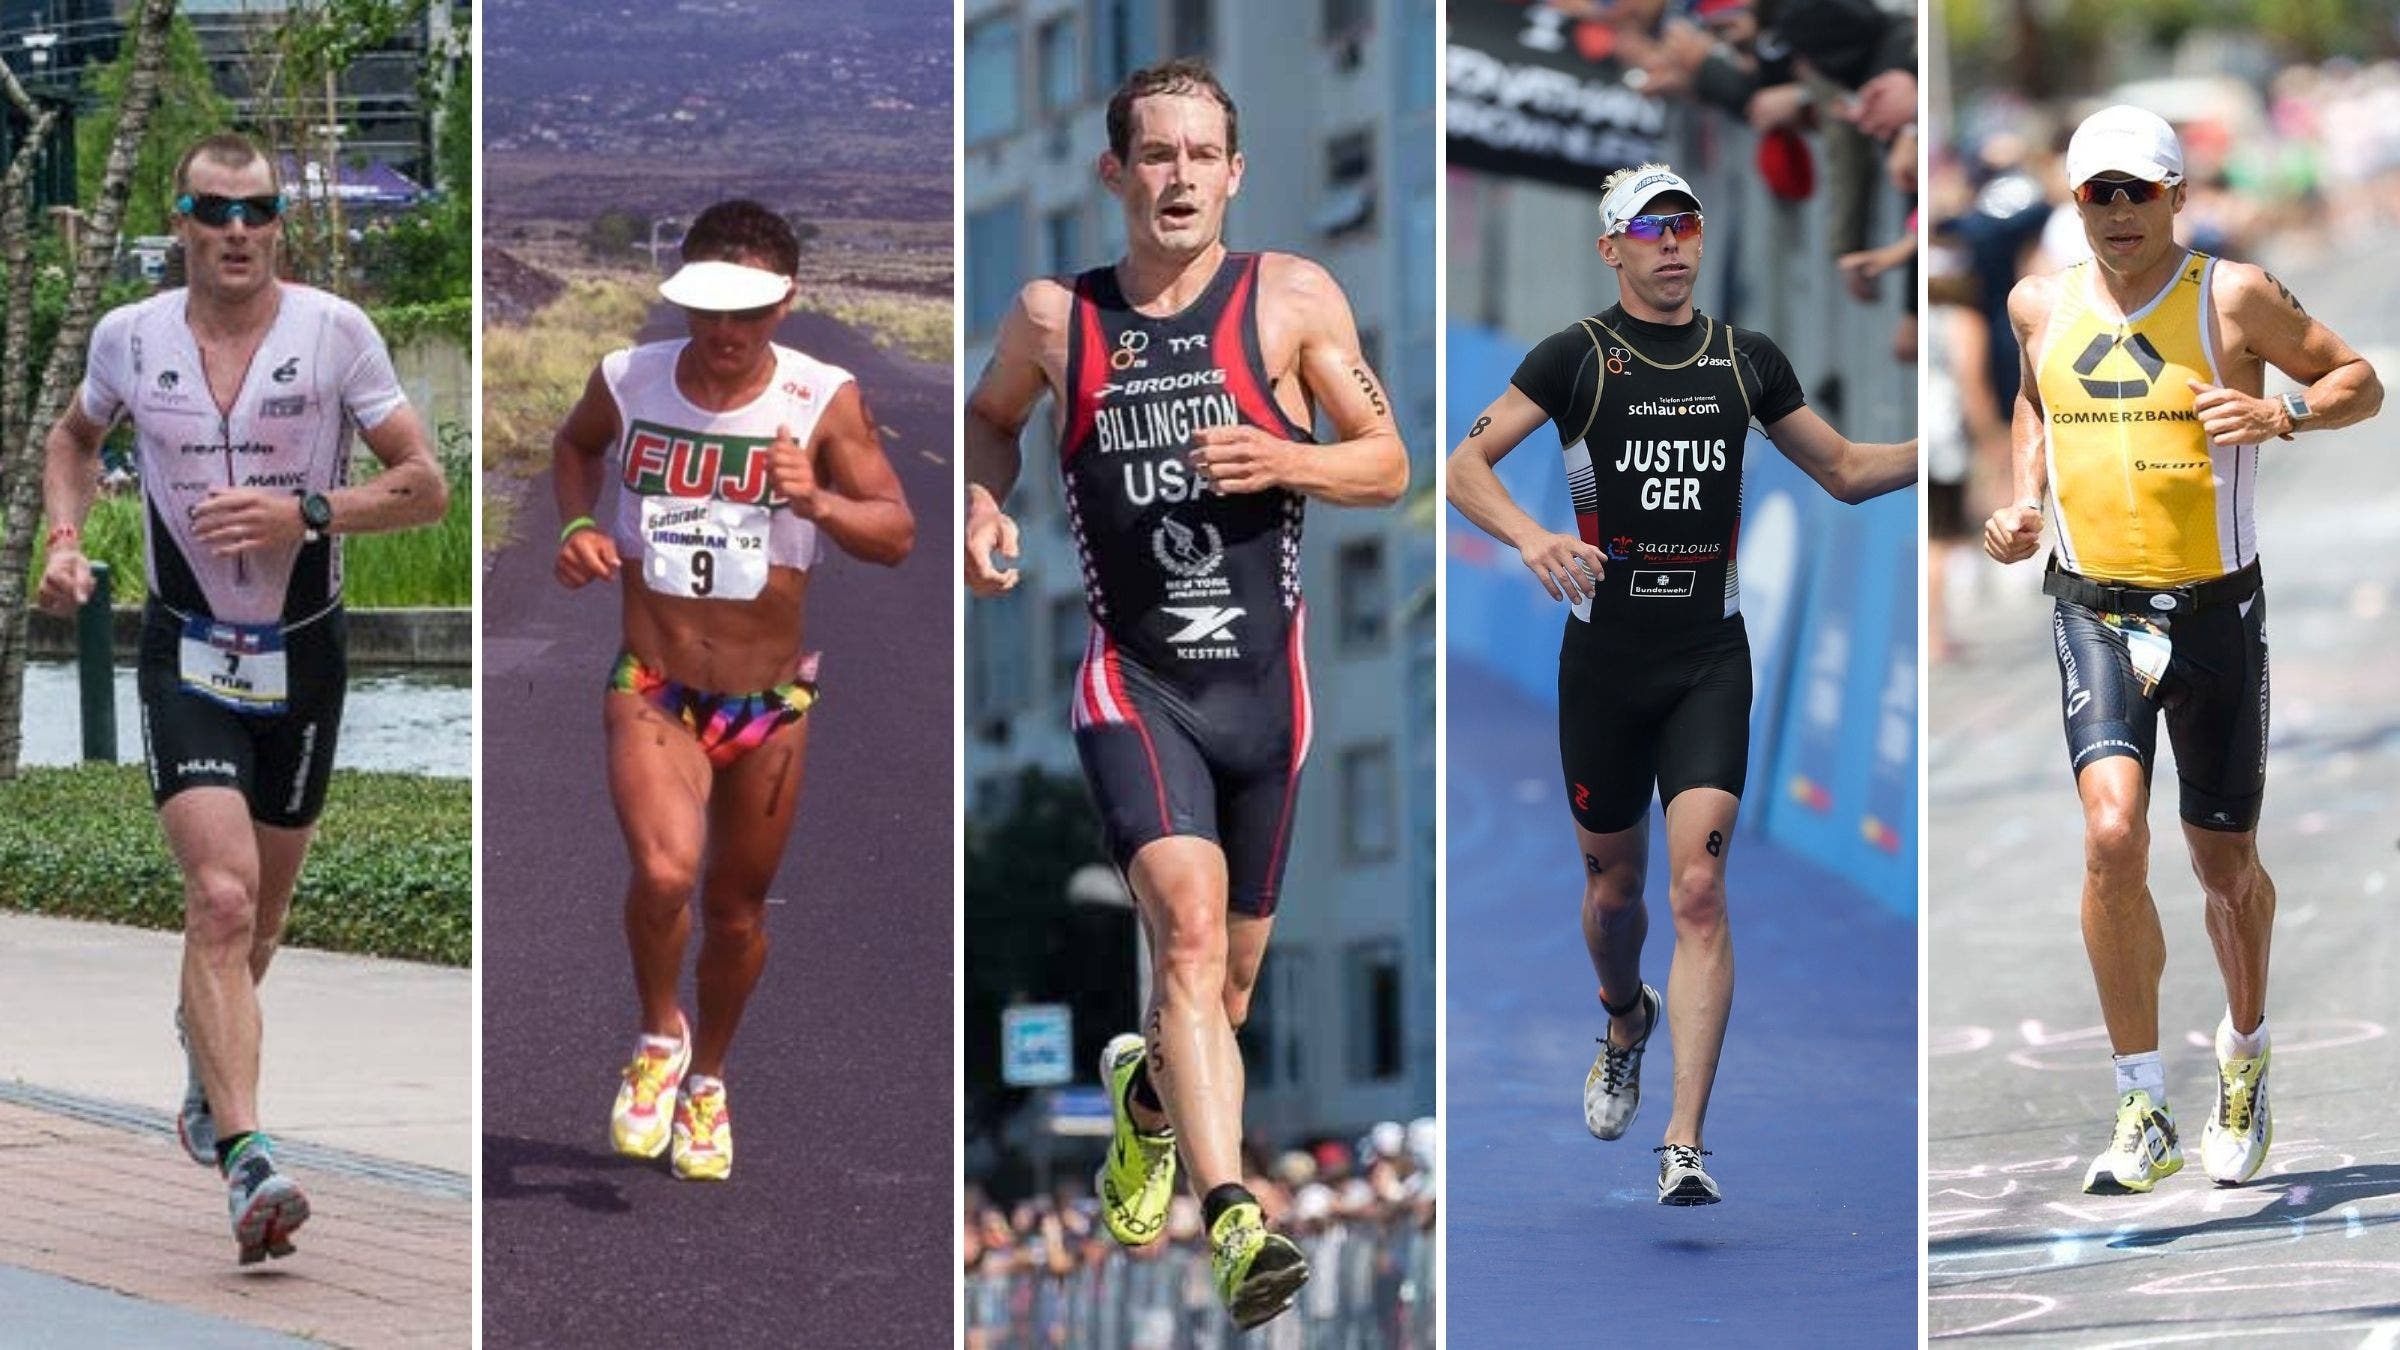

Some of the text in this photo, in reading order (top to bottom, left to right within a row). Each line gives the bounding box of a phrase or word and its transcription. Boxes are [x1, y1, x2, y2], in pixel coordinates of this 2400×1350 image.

[1168, 334, 1208, 354] TYR
[1709, 358, 1732, 367] asics
[1124, 369, 1227, 396] BROOKS
[1095, 393, 1239, 453] BILLINGTON
[1469, 416, 1491, 438] 8
[2052, 409, 2198, 425] COMMERZBANK
[1615, 438, 1726, 473] JUSTUS
[2149, 461, 2209, 470] SCOTT
[1640, 477, 1702, 511] GER
[648, 507, 707, 530] Gatorade
[652, 529, 728, 549] IRONMAN
[691, 550, 714, 597] 9
[1635, 586, 1688, 594] Bundeswehr
[1177, 646, 1240, 659] KESTREL
[2053, 611, 2081, 699] COMMERZBANK
[1706, 830, 1722, 858] 8
